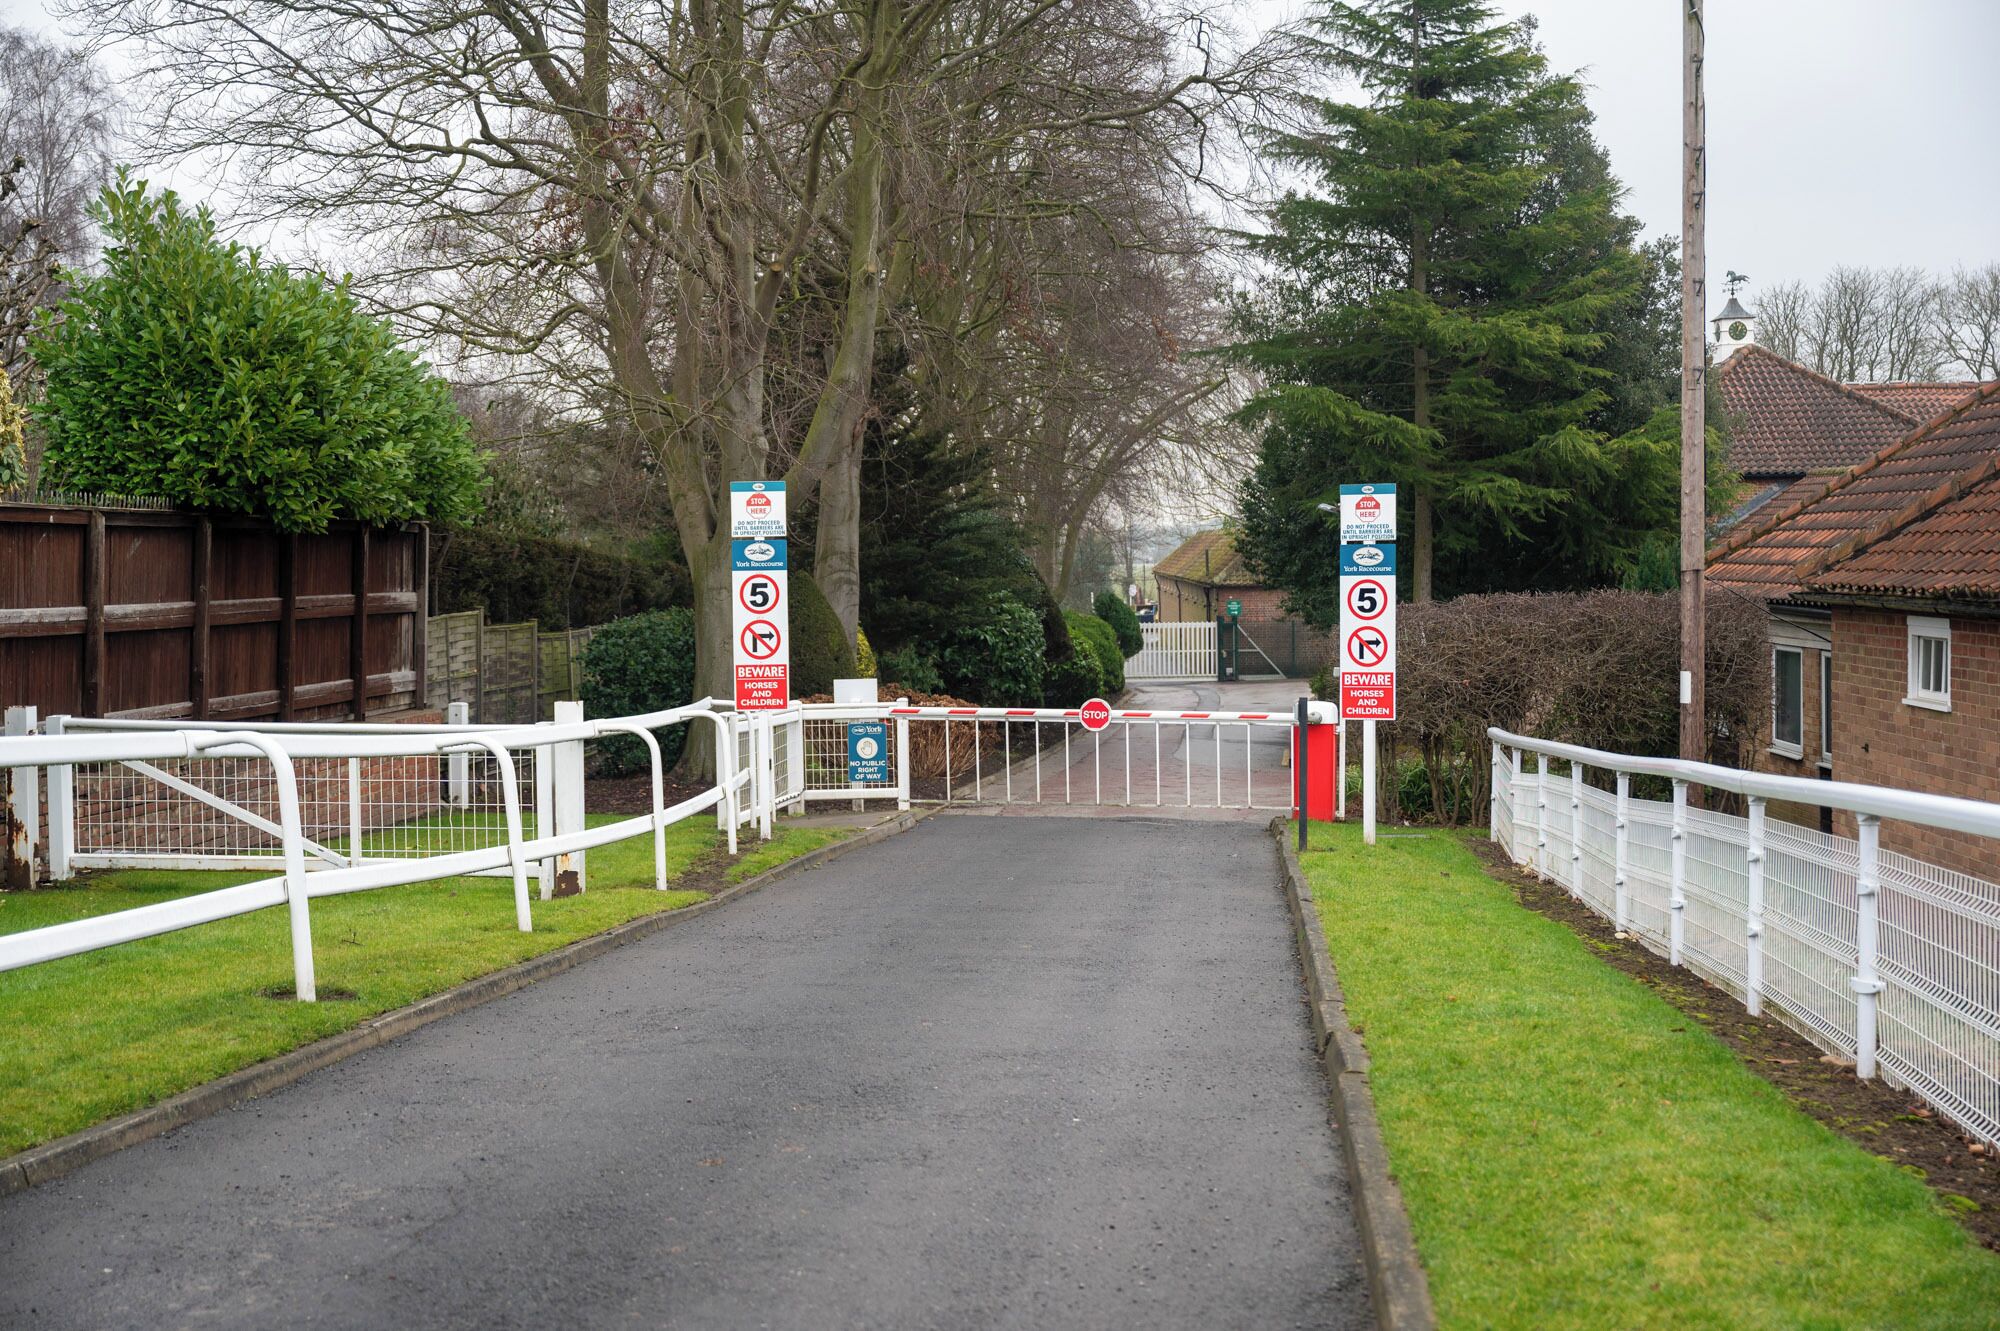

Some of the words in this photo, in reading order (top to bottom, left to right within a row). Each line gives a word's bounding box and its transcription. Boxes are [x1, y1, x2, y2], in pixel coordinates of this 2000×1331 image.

[750, 583, 769, 607] 5
[1357, 588, 1377, 613] 5
[738, 666, 784, 677] BEWARE
[1344, 674, 1391, 685] BEWARE
[1083, 710, 1108, 719] STOP
